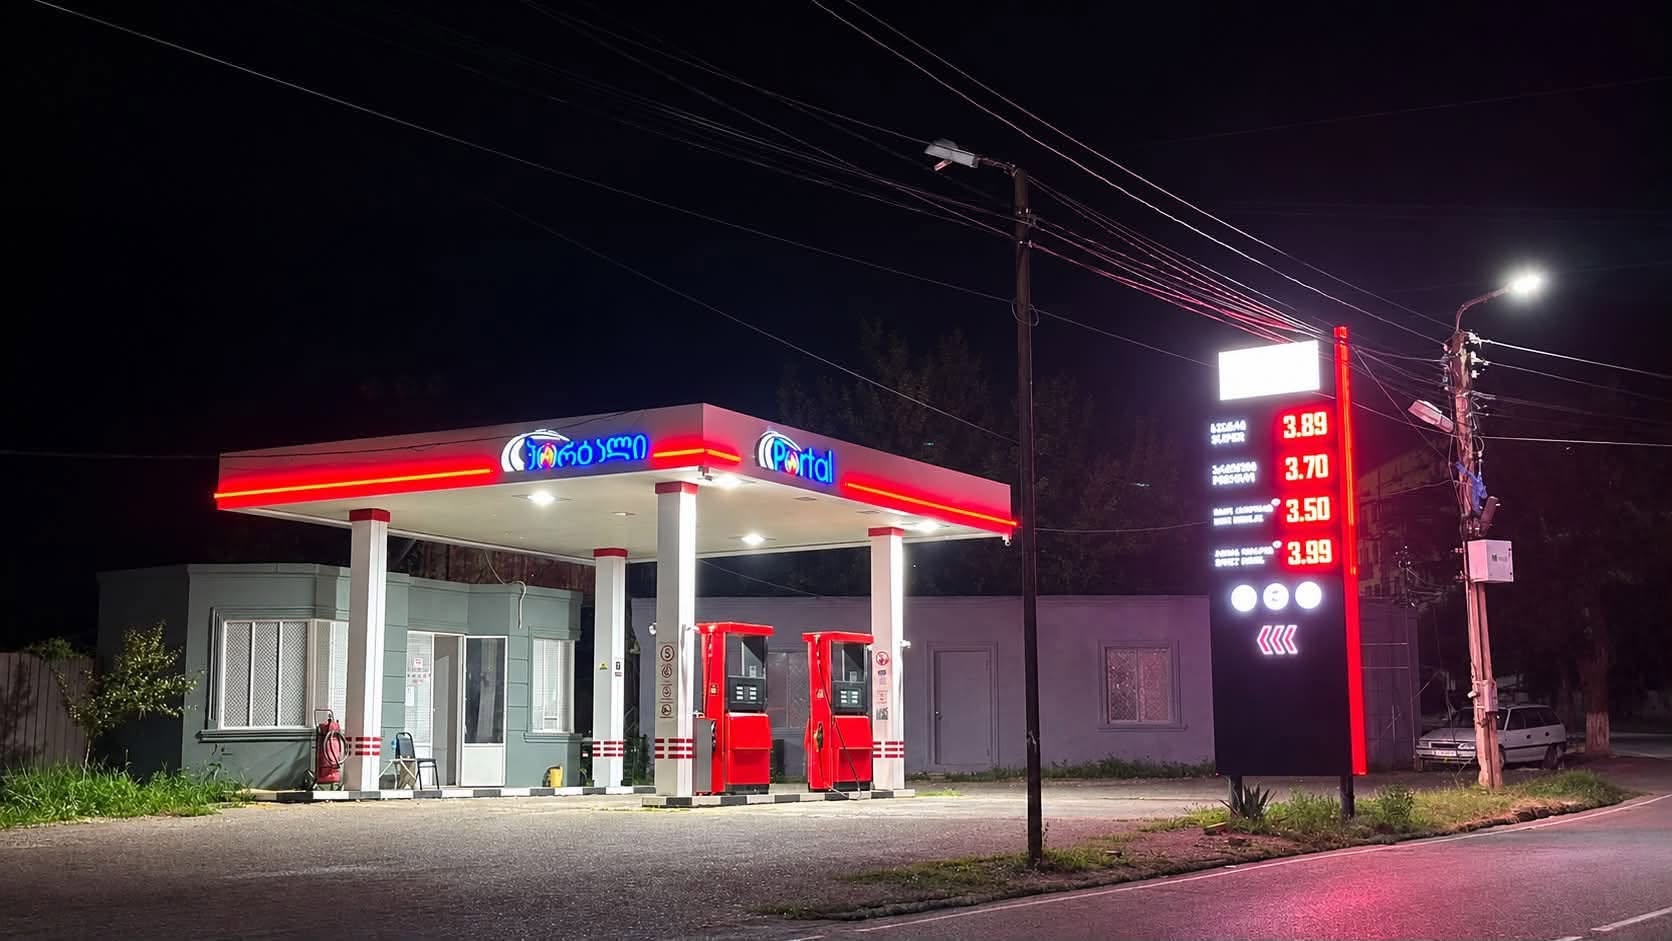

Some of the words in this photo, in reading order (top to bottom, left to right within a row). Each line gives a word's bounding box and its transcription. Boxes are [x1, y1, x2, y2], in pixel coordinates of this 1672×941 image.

[1283, 411, 1328, 439] 3.89
[773, 437, 833, 483] Portal
[1285, 453, 1329, 482] 3.70
[1286, 496, 1330, 523] 3.50
[1287, 539, 1332, 566] 3.99
